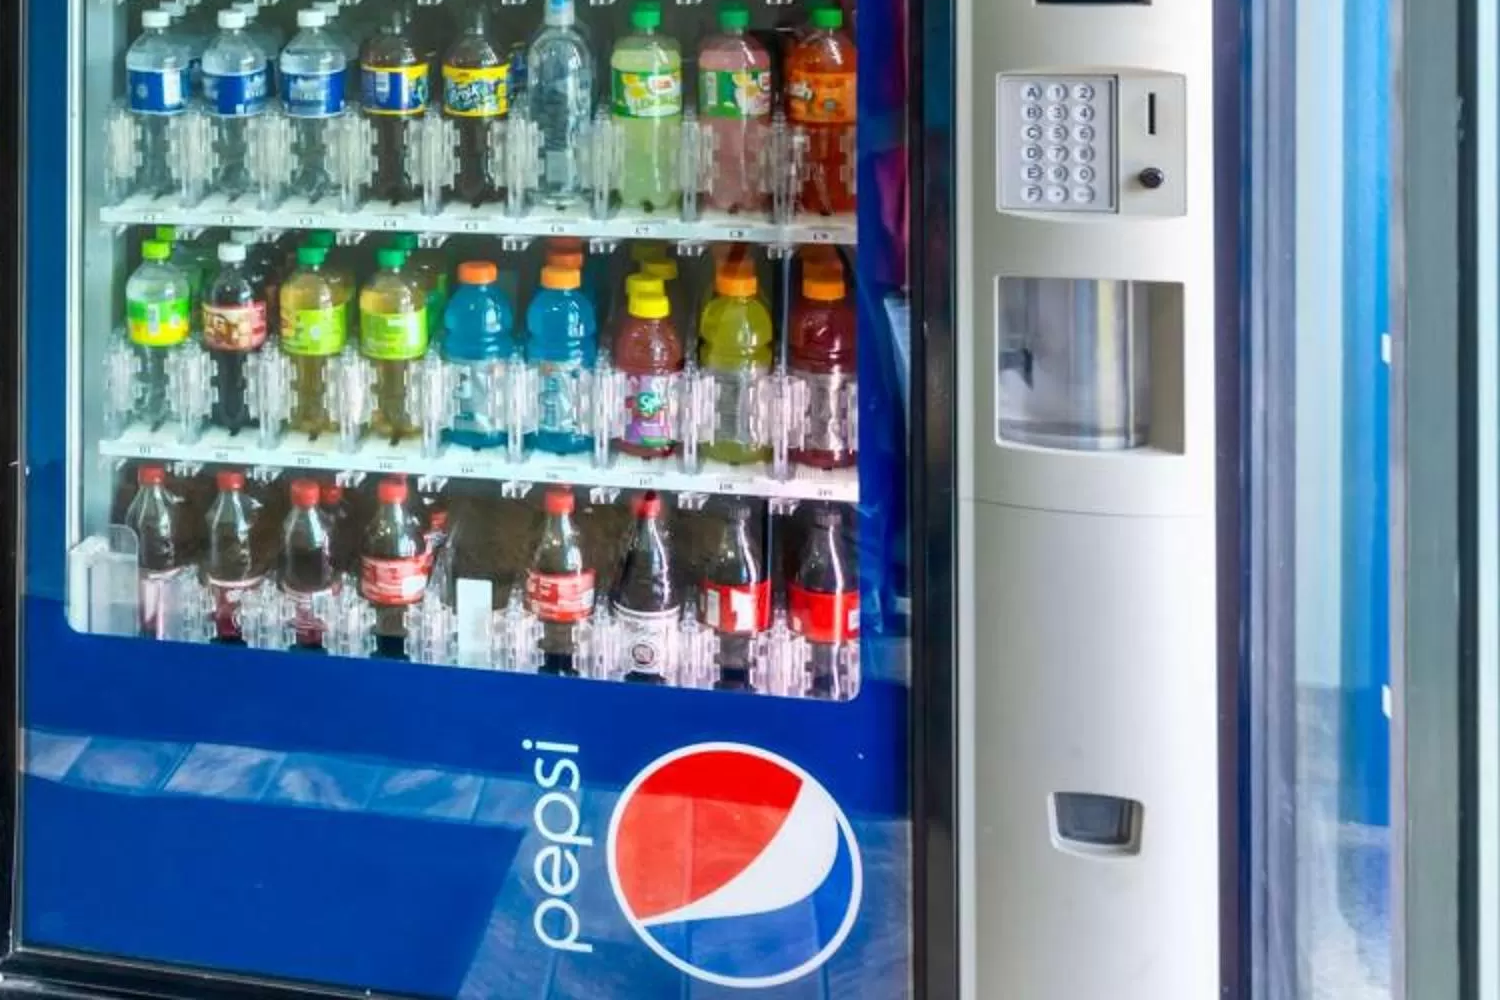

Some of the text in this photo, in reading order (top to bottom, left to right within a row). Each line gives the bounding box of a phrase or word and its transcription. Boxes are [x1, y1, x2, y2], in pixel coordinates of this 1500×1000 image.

[1027, 87, 1038, 97] A
[1079, 87, 1089, 97] 2
[1027, 107, 1089, 118] B 3 4
[1027, 127, 1089, 138] C 5 6
[1027, 148, 1038, 159] D
[1054, 148, 1063, 159] 7
[1027, 168, 1089, 179] E 9 0
[1027, 188, 1037, 198] F
[521, 738, 593, 953] pepsi
